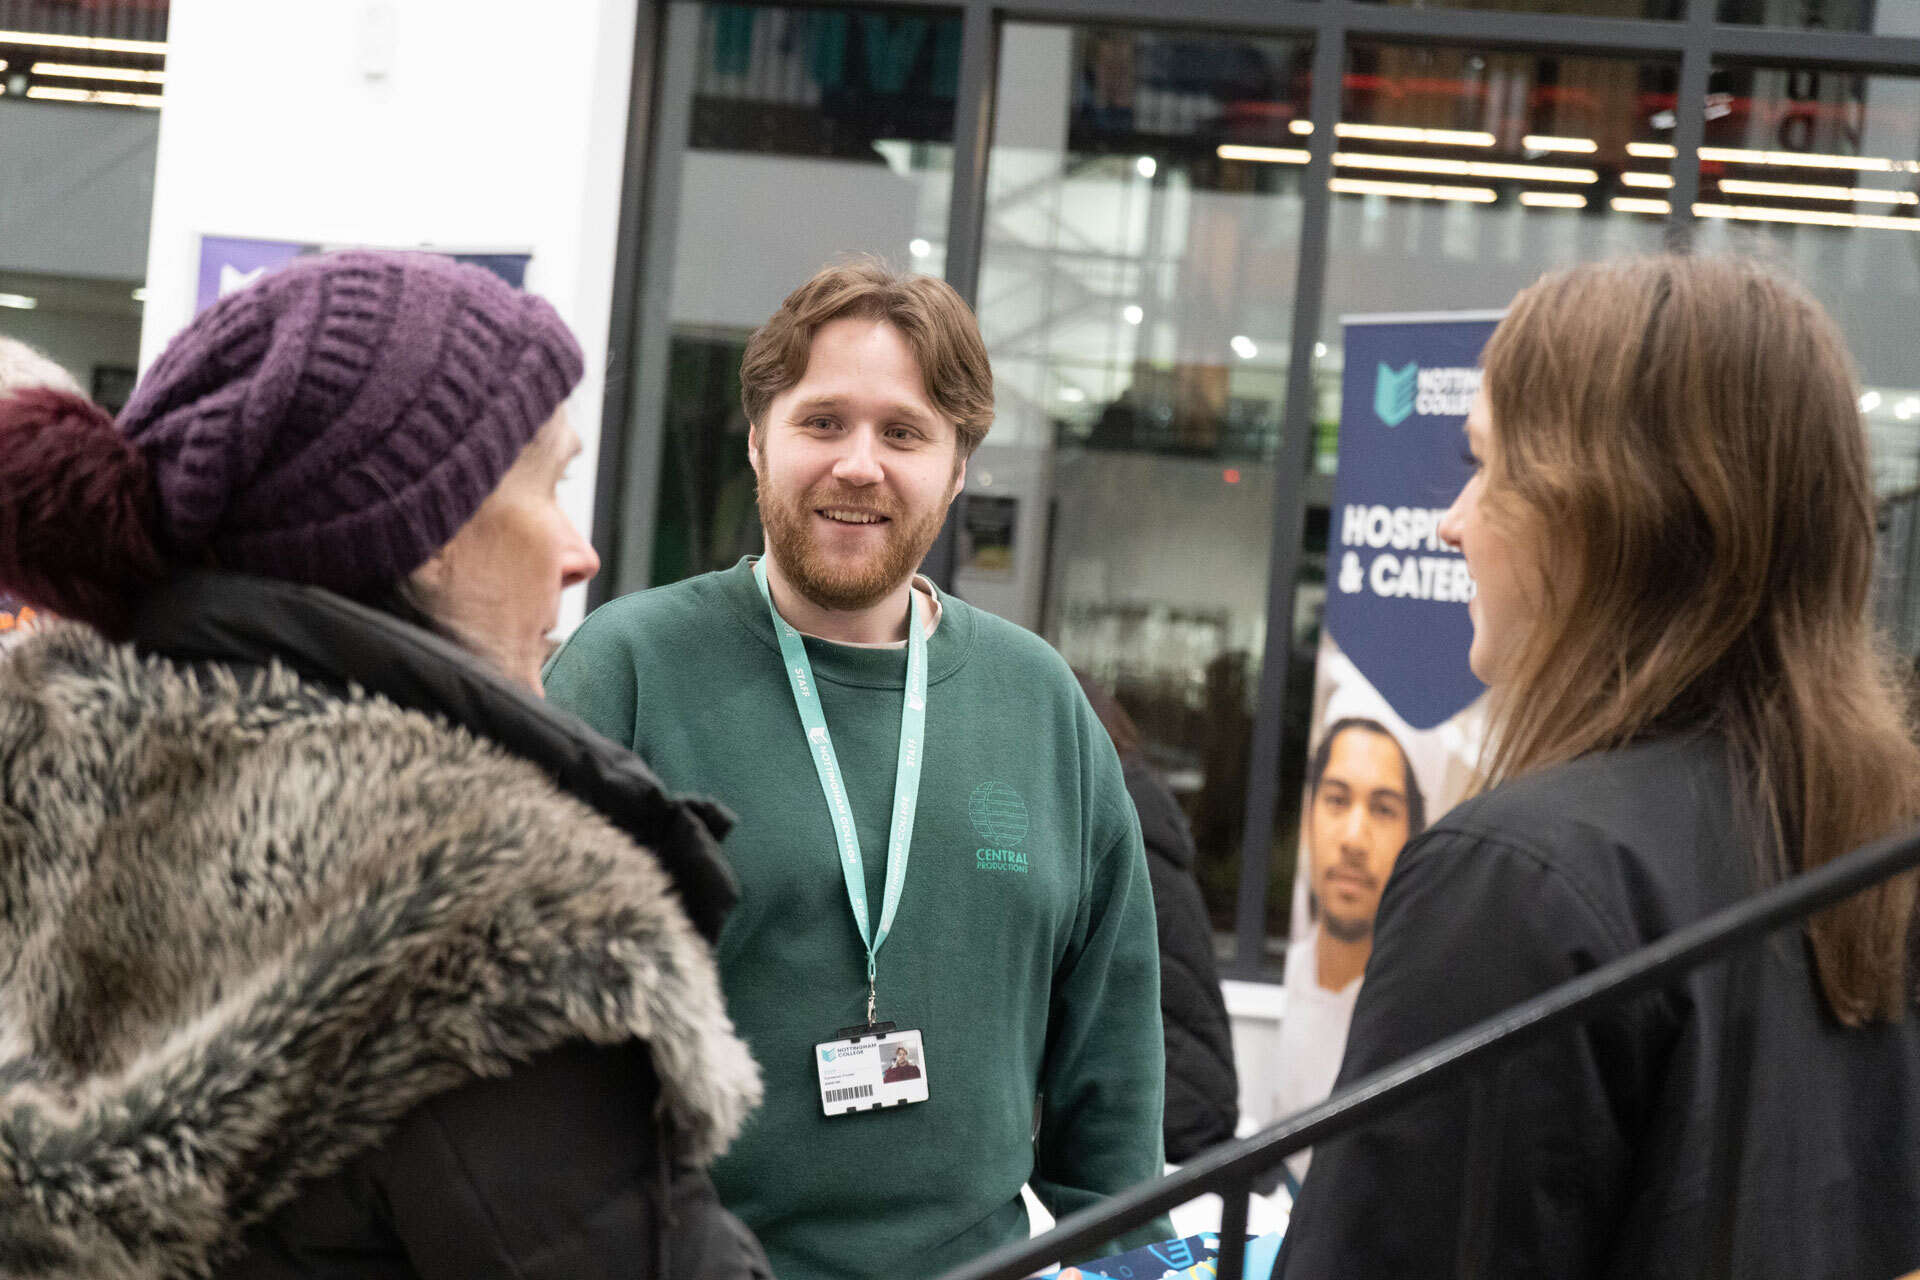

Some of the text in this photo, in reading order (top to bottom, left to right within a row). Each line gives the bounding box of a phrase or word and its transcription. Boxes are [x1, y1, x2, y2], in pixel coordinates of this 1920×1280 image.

[1418, 367, 1484, 392] NOTTIN
[1416, 394, 1471, 415] COLLE
[1342, 503, 1461, 552] HOSPI
[1338, 550, 1364, 594] &
[795, 668, 811, 697] STAFF
[907, 738, 918, 767] STAFF
[819, 745, 857, 865] NOTTINGHAM COLLEGE
[888, 796, 910, 913] NOTTINGHAM COLLEGE
[976, 848, 1029, 865] CENTRAL
[977, 861, 1029, 873] PRODUCTIONS
[837, 1043, 877, 1053] NOTTINGHAM
[838, 1050, 864, 1058] COLLEGE
